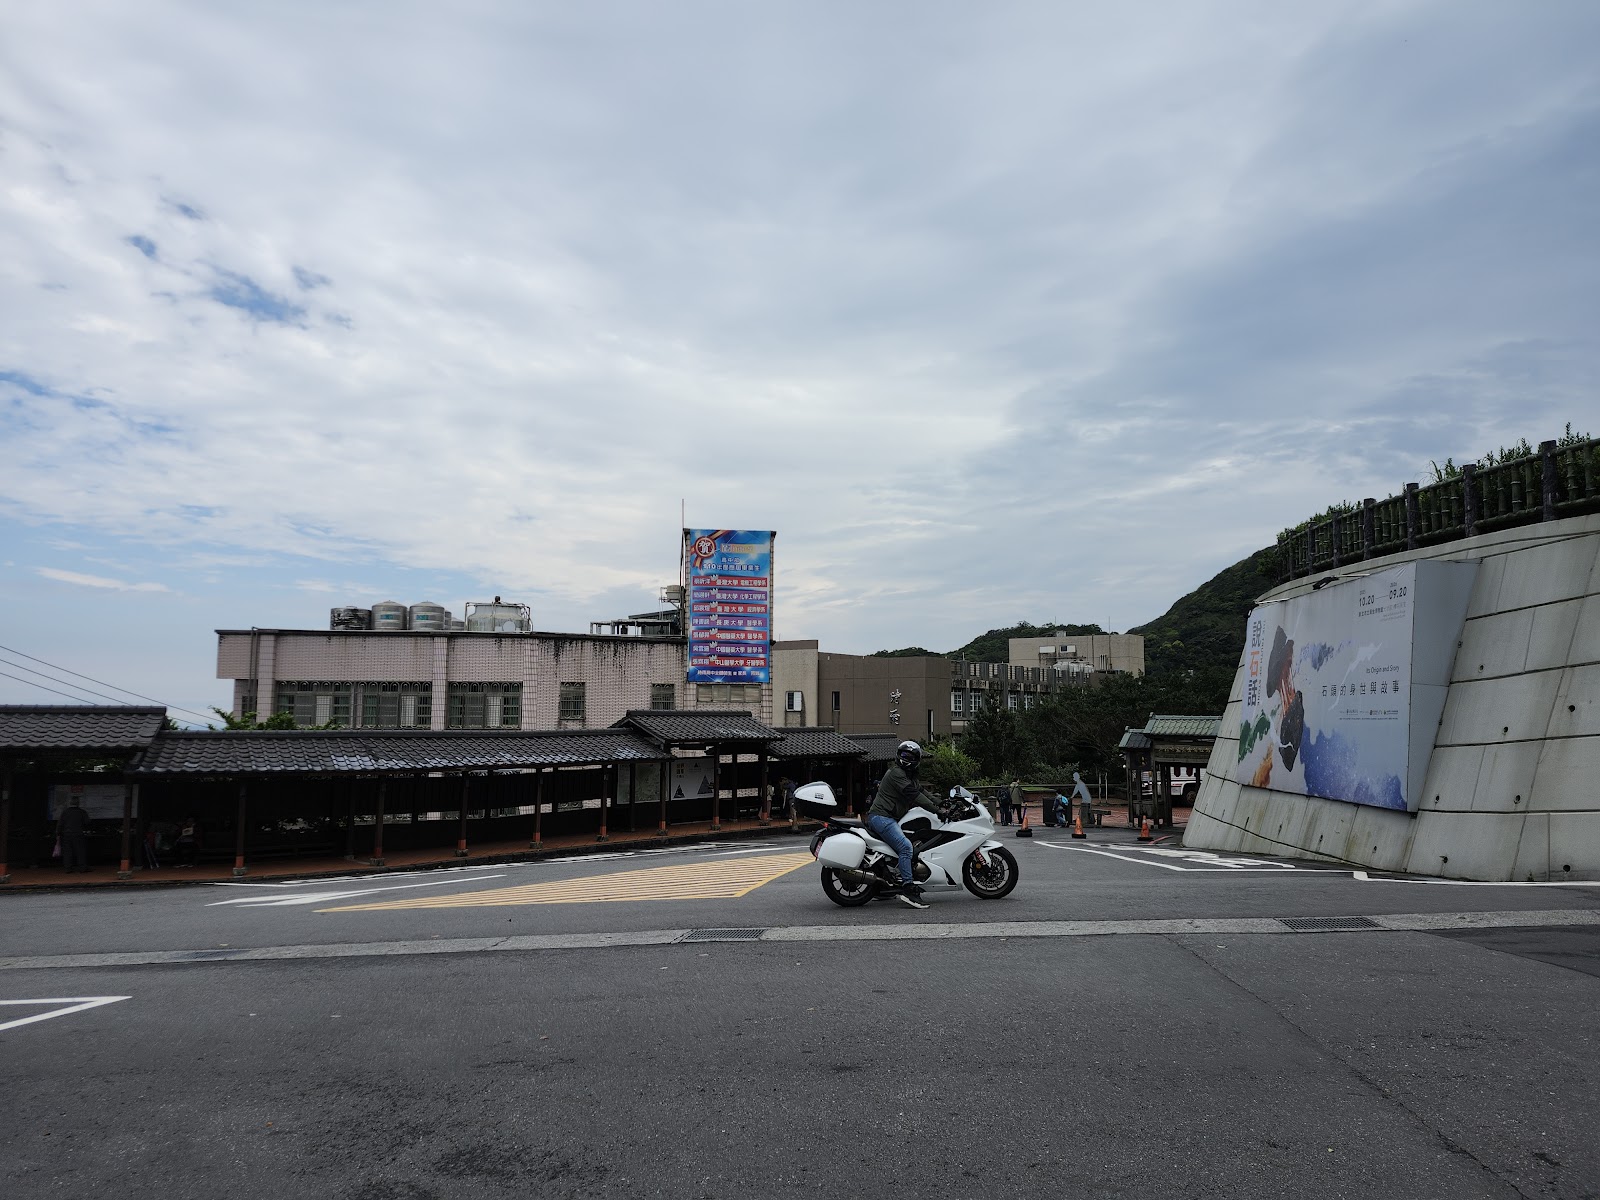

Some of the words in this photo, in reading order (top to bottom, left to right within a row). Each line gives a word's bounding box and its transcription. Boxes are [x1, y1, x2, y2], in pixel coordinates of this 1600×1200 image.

[699, 540, 711, 554] 賀
[1359, 594, 1375, 607] 10.20
[1388, 586, 1407, 600] 09.20
[1371, 666, 1381, 675] Origin
[1389, 664, 1399, 673] Story
[1321, 679, 1399, 697] 石頭的身世與故事
